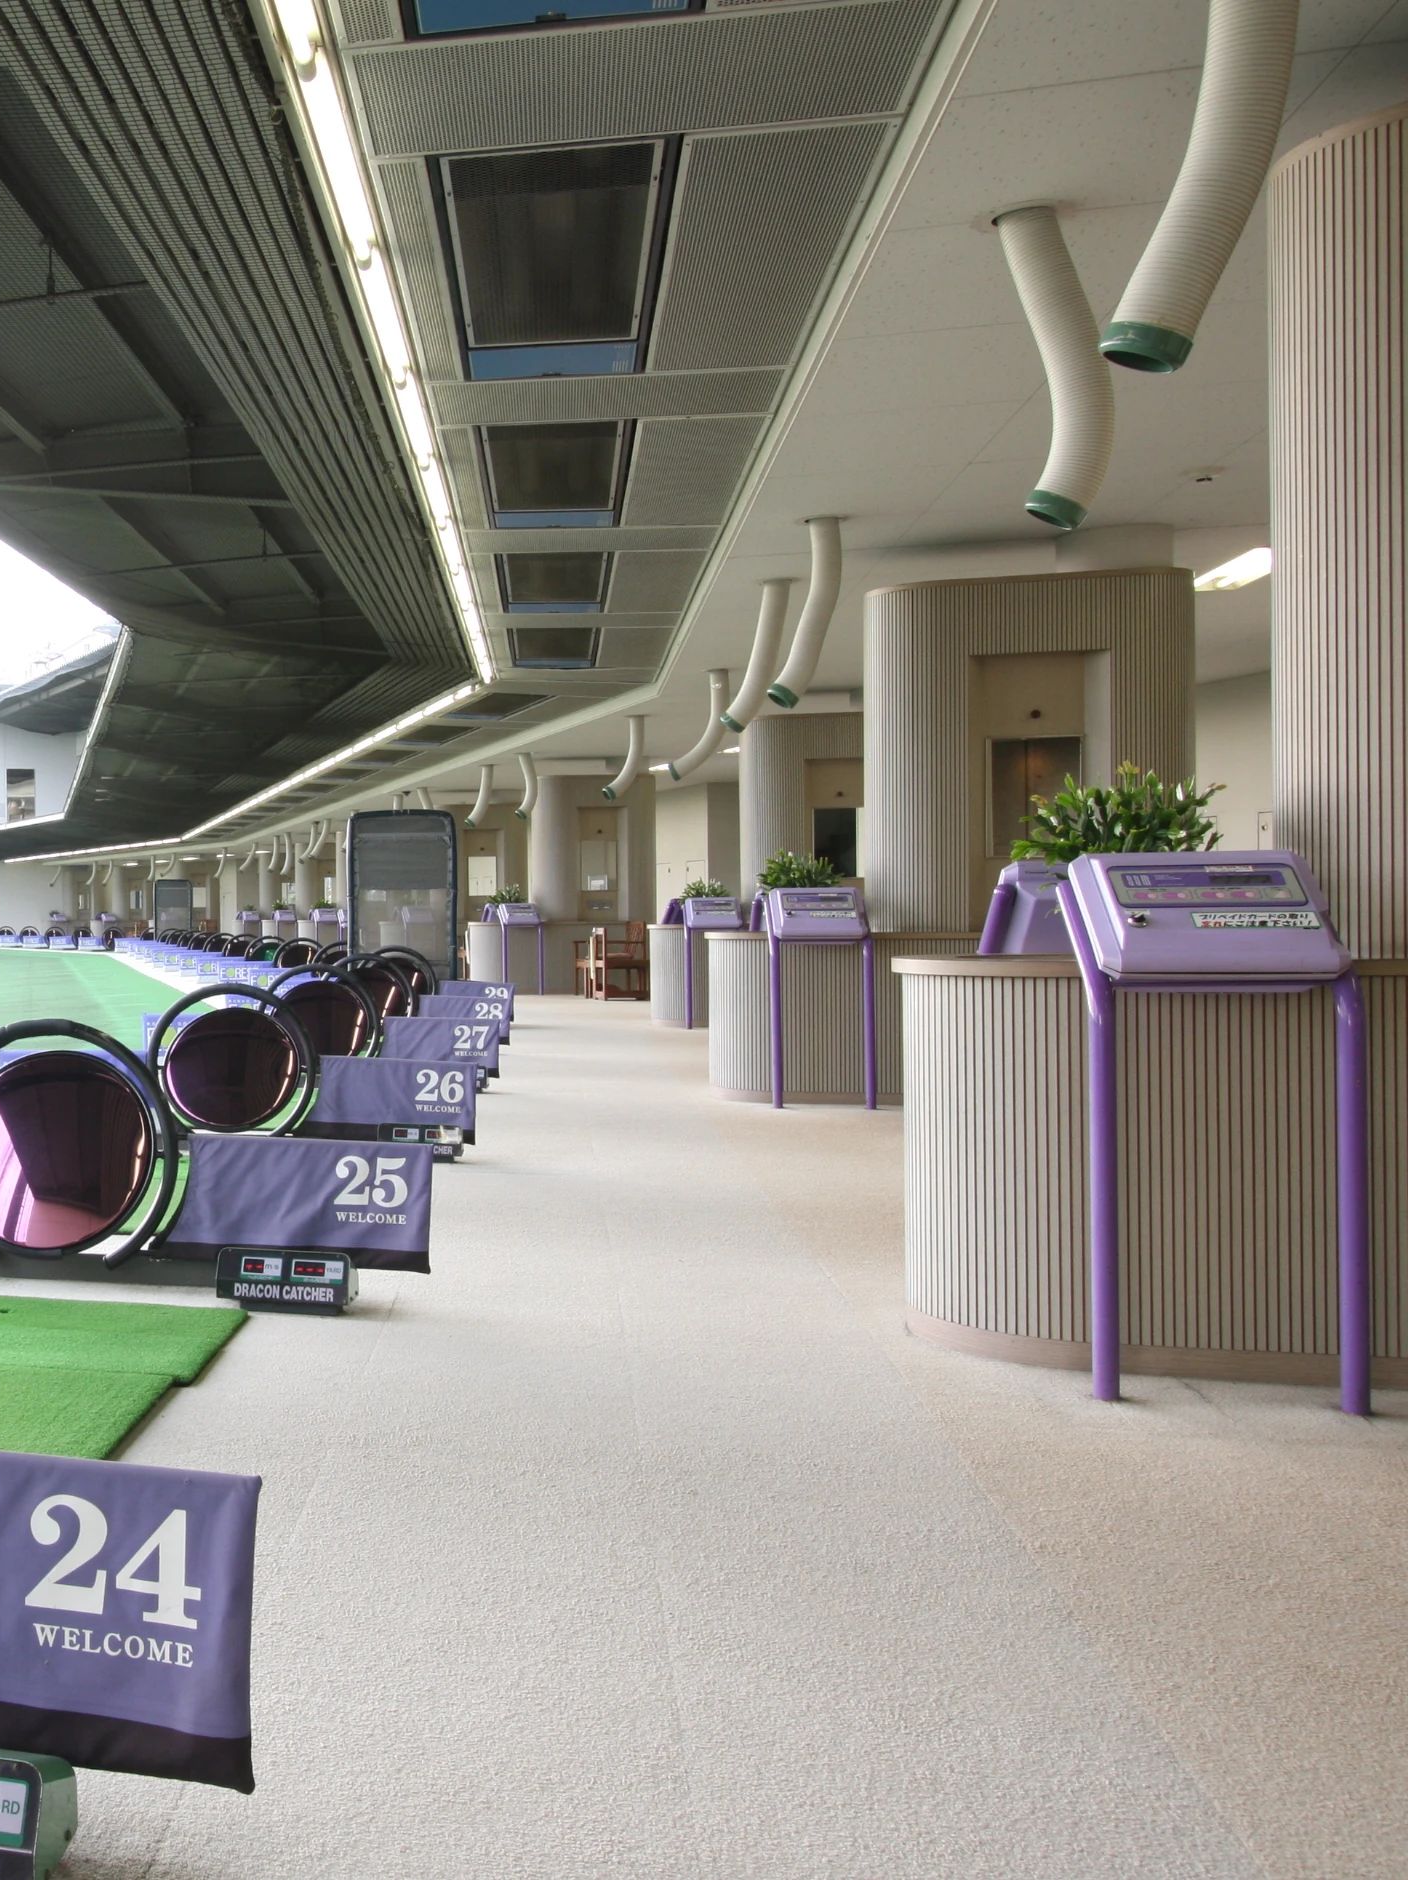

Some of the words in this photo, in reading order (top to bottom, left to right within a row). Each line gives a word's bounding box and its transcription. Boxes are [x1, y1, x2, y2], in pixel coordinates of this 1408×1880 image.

[484, 986, 509, 999] 29
[475, 1002, 503, 1019] 28
[453, 1025, 490, 1050] 27
[415, 1069, 465, 1103] 26
[415, 1104, 462, 1114] WELCOME
[433, 1145, 453, 1155] CHER
[334, 1155, 408, 1208] 25
[336, 1211, 407, 1226] WELCOME
[234, 1282, 280, 1299] DRACON
[282, 1285, 334, 1302] CATCHER
[25, 1494, 201, 1629] 24
[33, 1622, 194, 1668] WELCOME
